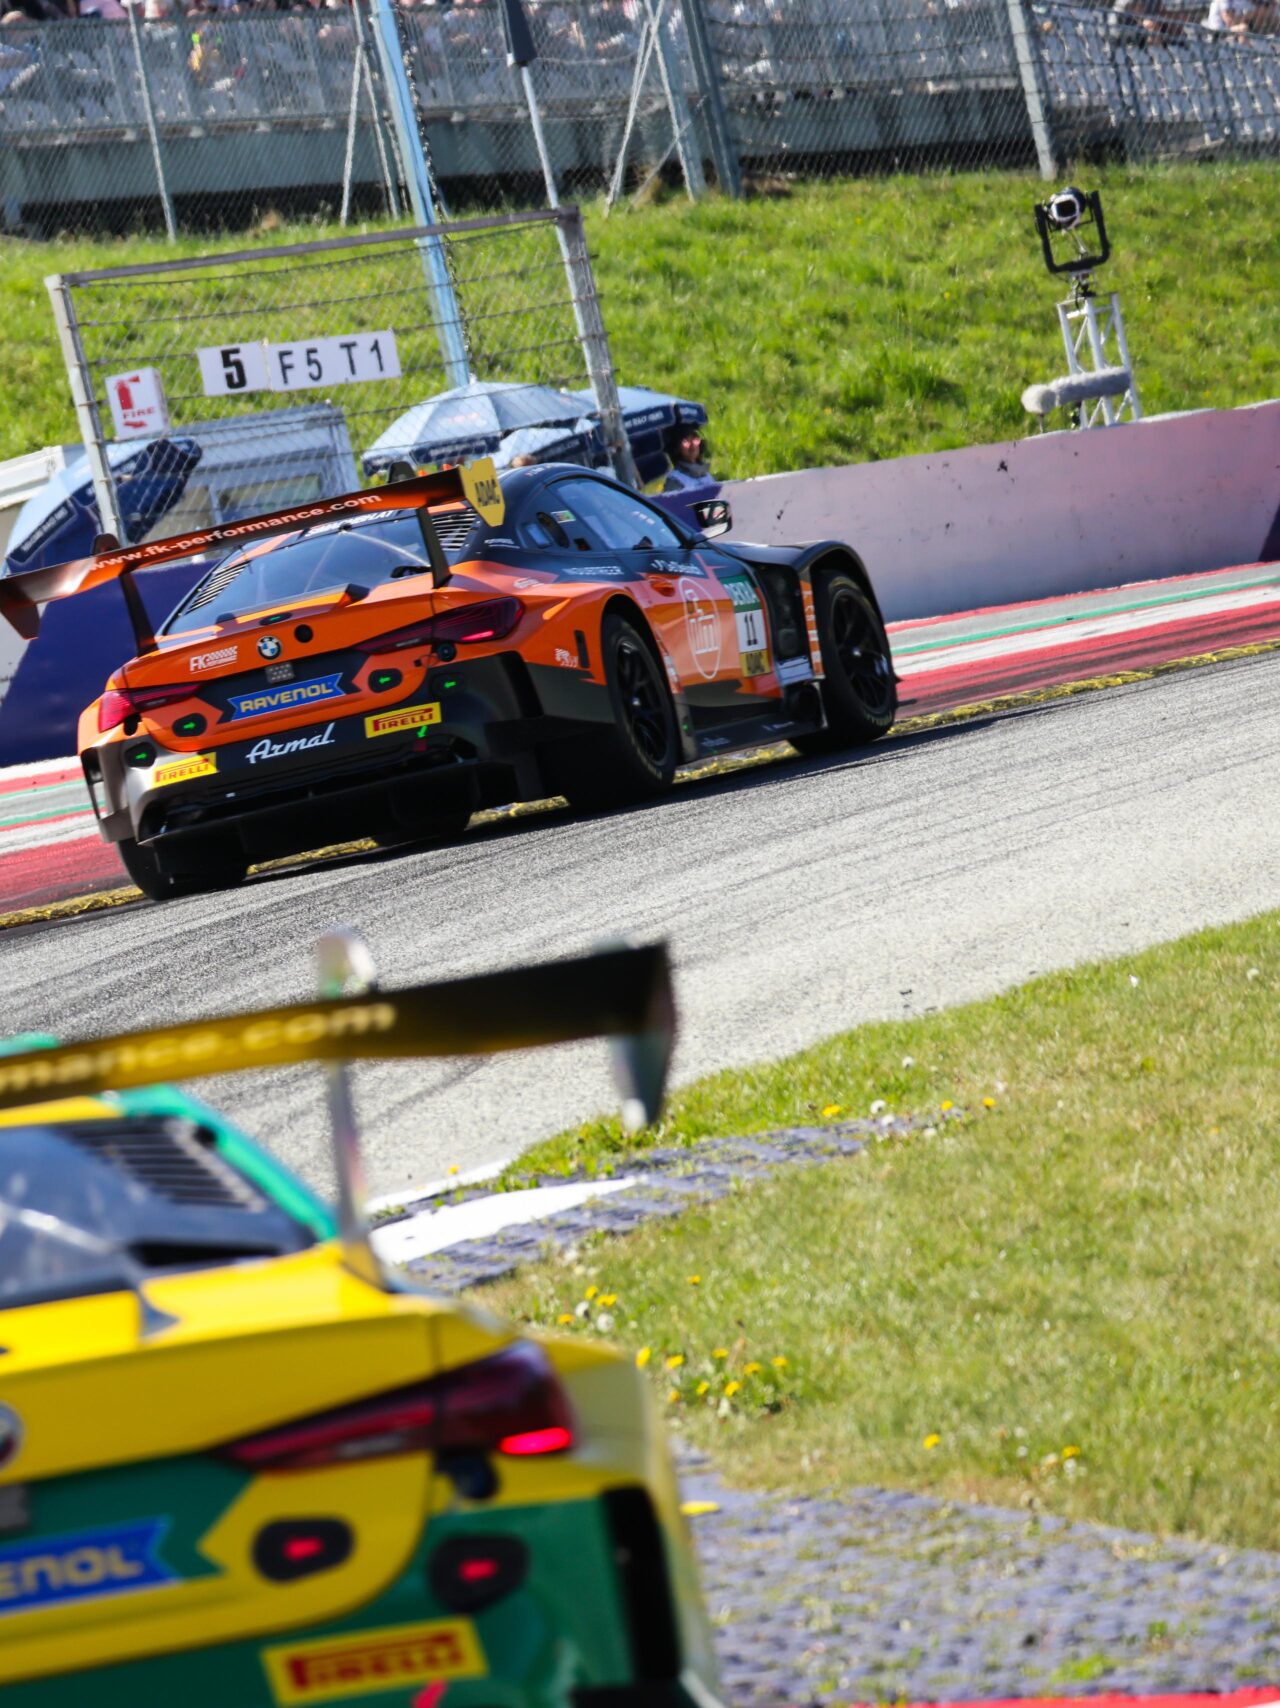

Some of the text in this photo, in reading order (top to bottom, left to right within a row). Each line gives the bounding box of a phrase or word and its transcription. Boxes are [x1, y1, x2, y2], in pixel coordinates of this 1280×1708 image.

[220, 347, 247, 390] 5
[122, 406, 156, 419] FIRE
[88, 493, 383, 571] www.fk-performance.com
[744, 613, 758, 647] 11
[239, 682, 333, 713] RAVENOL
[372, 706, 434, 732] PIRELLI
[245, 722, 335, 764] Armal
[155, 757, 209, 784] PIRELLI
